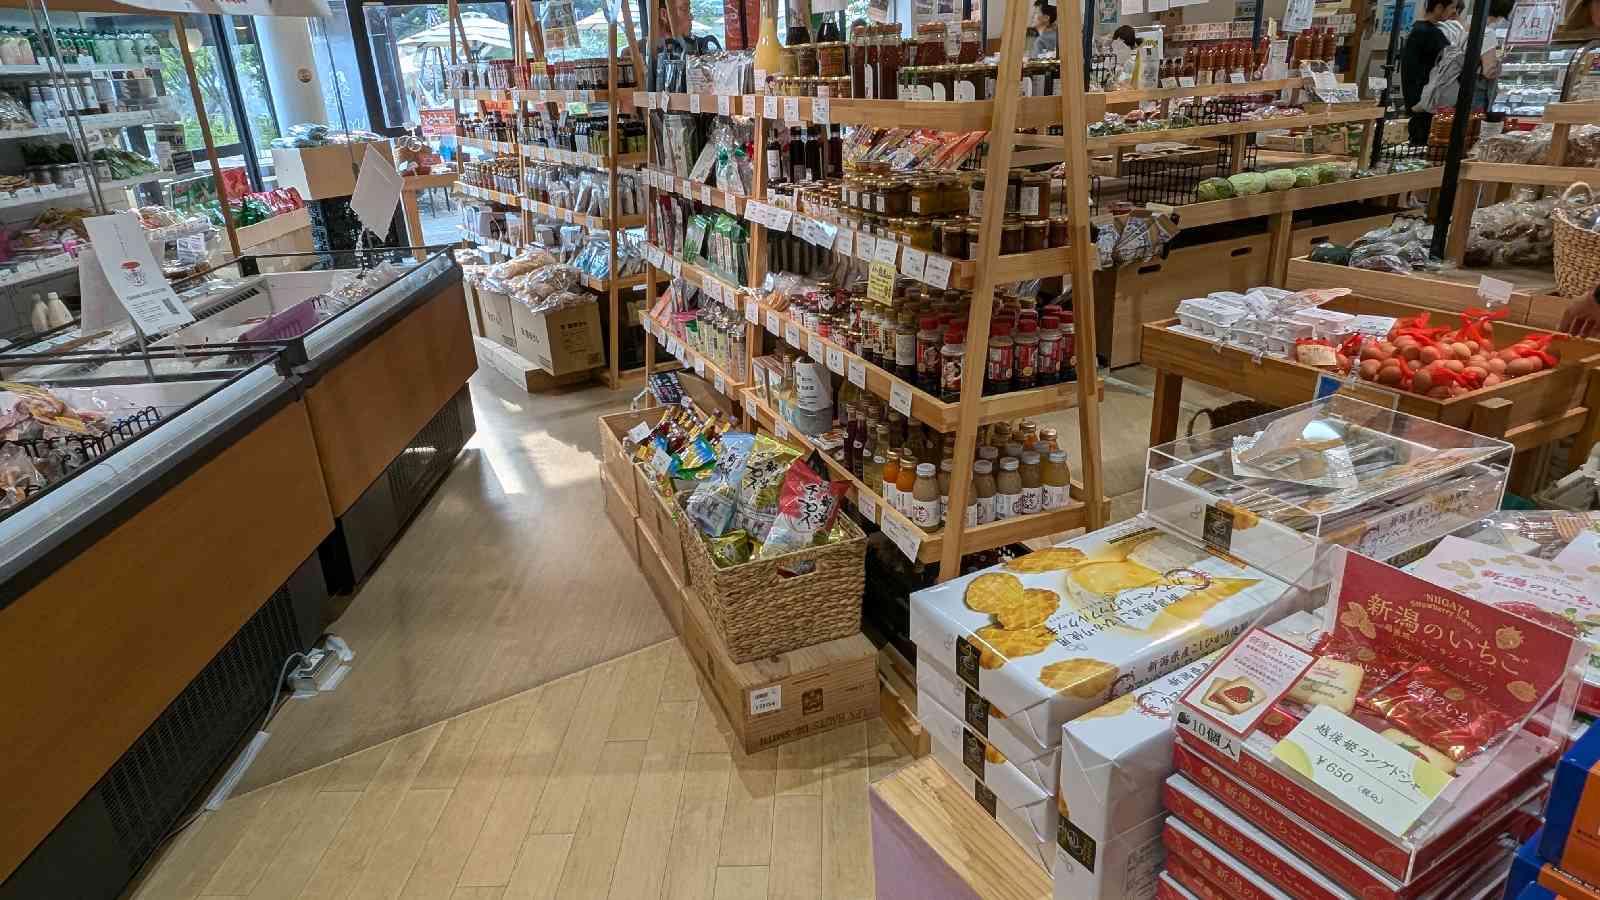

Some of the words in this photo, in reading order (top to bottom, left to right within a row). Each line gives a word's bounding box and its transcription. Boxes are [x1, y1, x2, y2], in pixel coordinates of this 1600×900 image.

[1367, 592, 1528, 676] 新潟のいちご
[1190, 720, 1237, 757] 10個入
